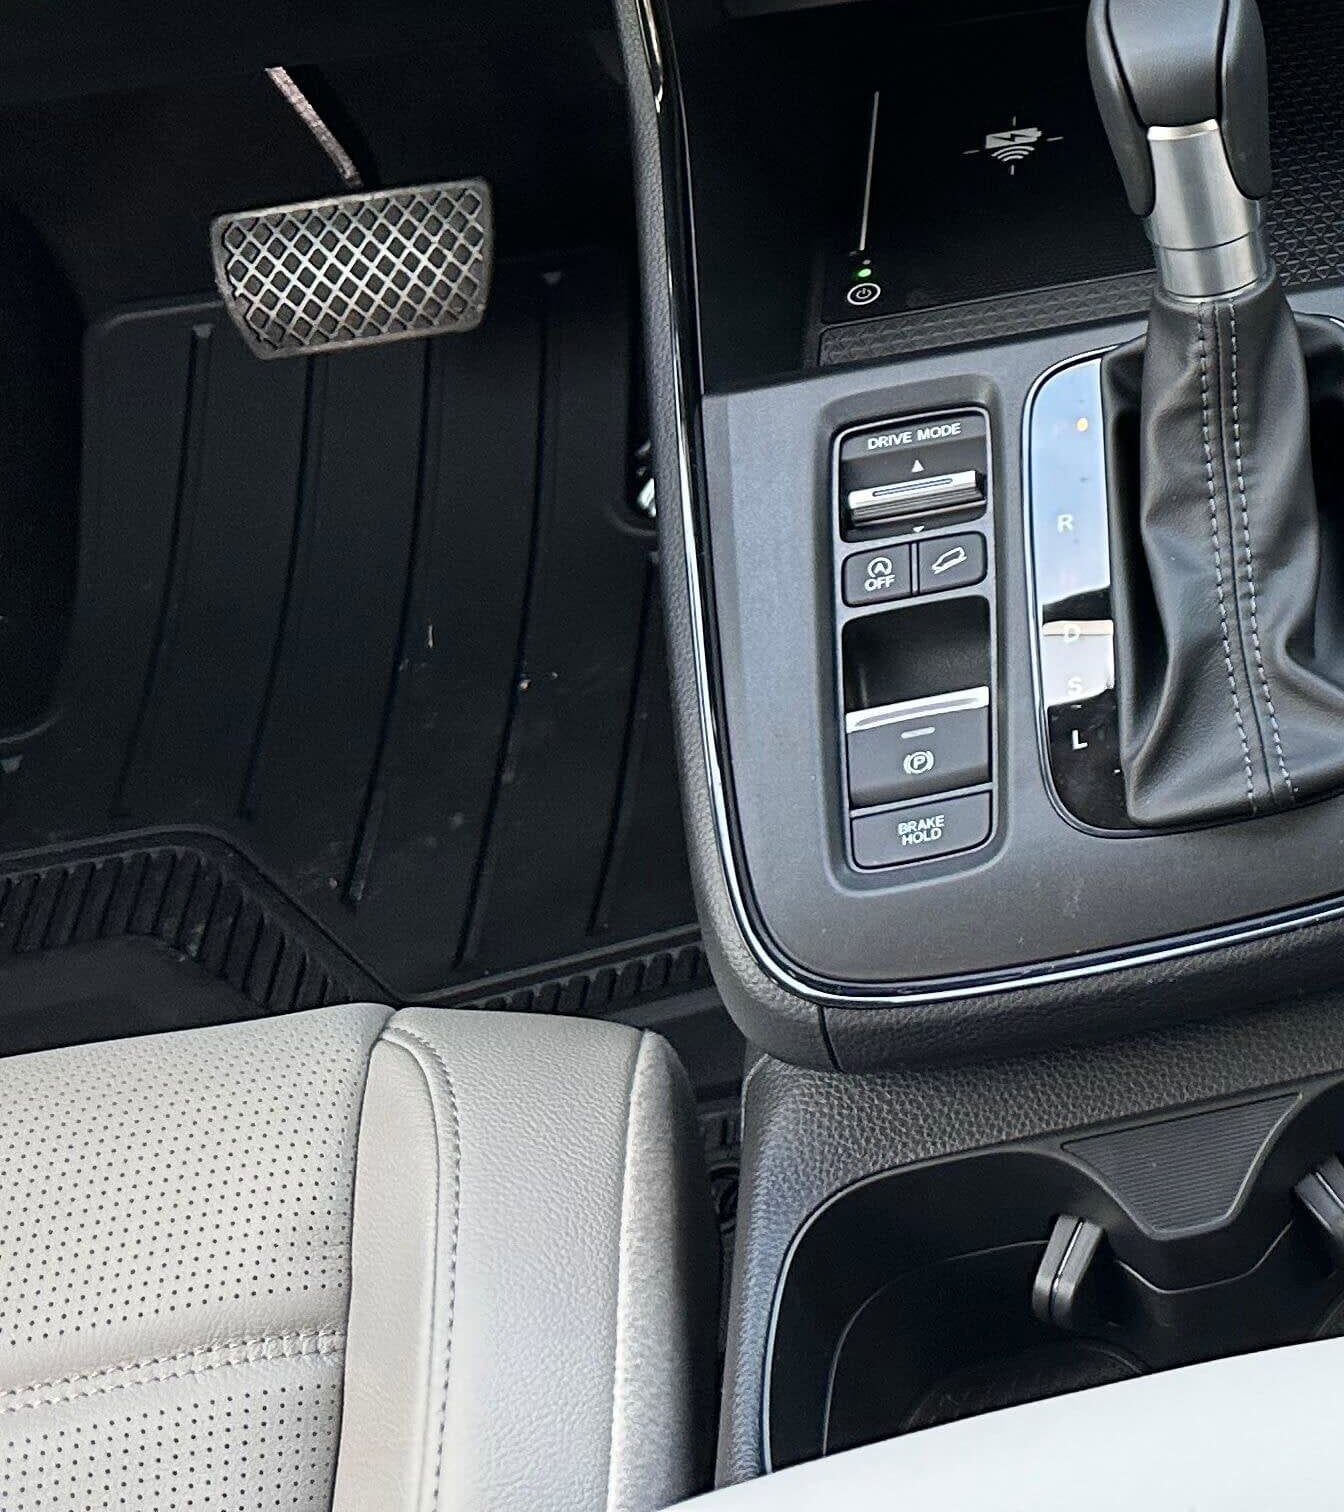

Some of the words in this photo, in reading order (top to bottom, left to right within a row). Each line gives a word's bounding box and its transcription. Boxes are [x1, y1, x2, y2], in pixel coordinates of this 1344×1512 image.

[867, 431, 913, 451] DRIVE
[917, 422, 962, 442] MODE
[1056, 513, 1074, 534] R
[864, 573, 896, 592] OFF
[1063, 623, 1081, 644] D
[1067, 676, 1082, 695] S
[1072, 729, 1088, 751] L
[897, 814, 945, 836] BRAKE
[901, 827, 942, 846] HOLD
